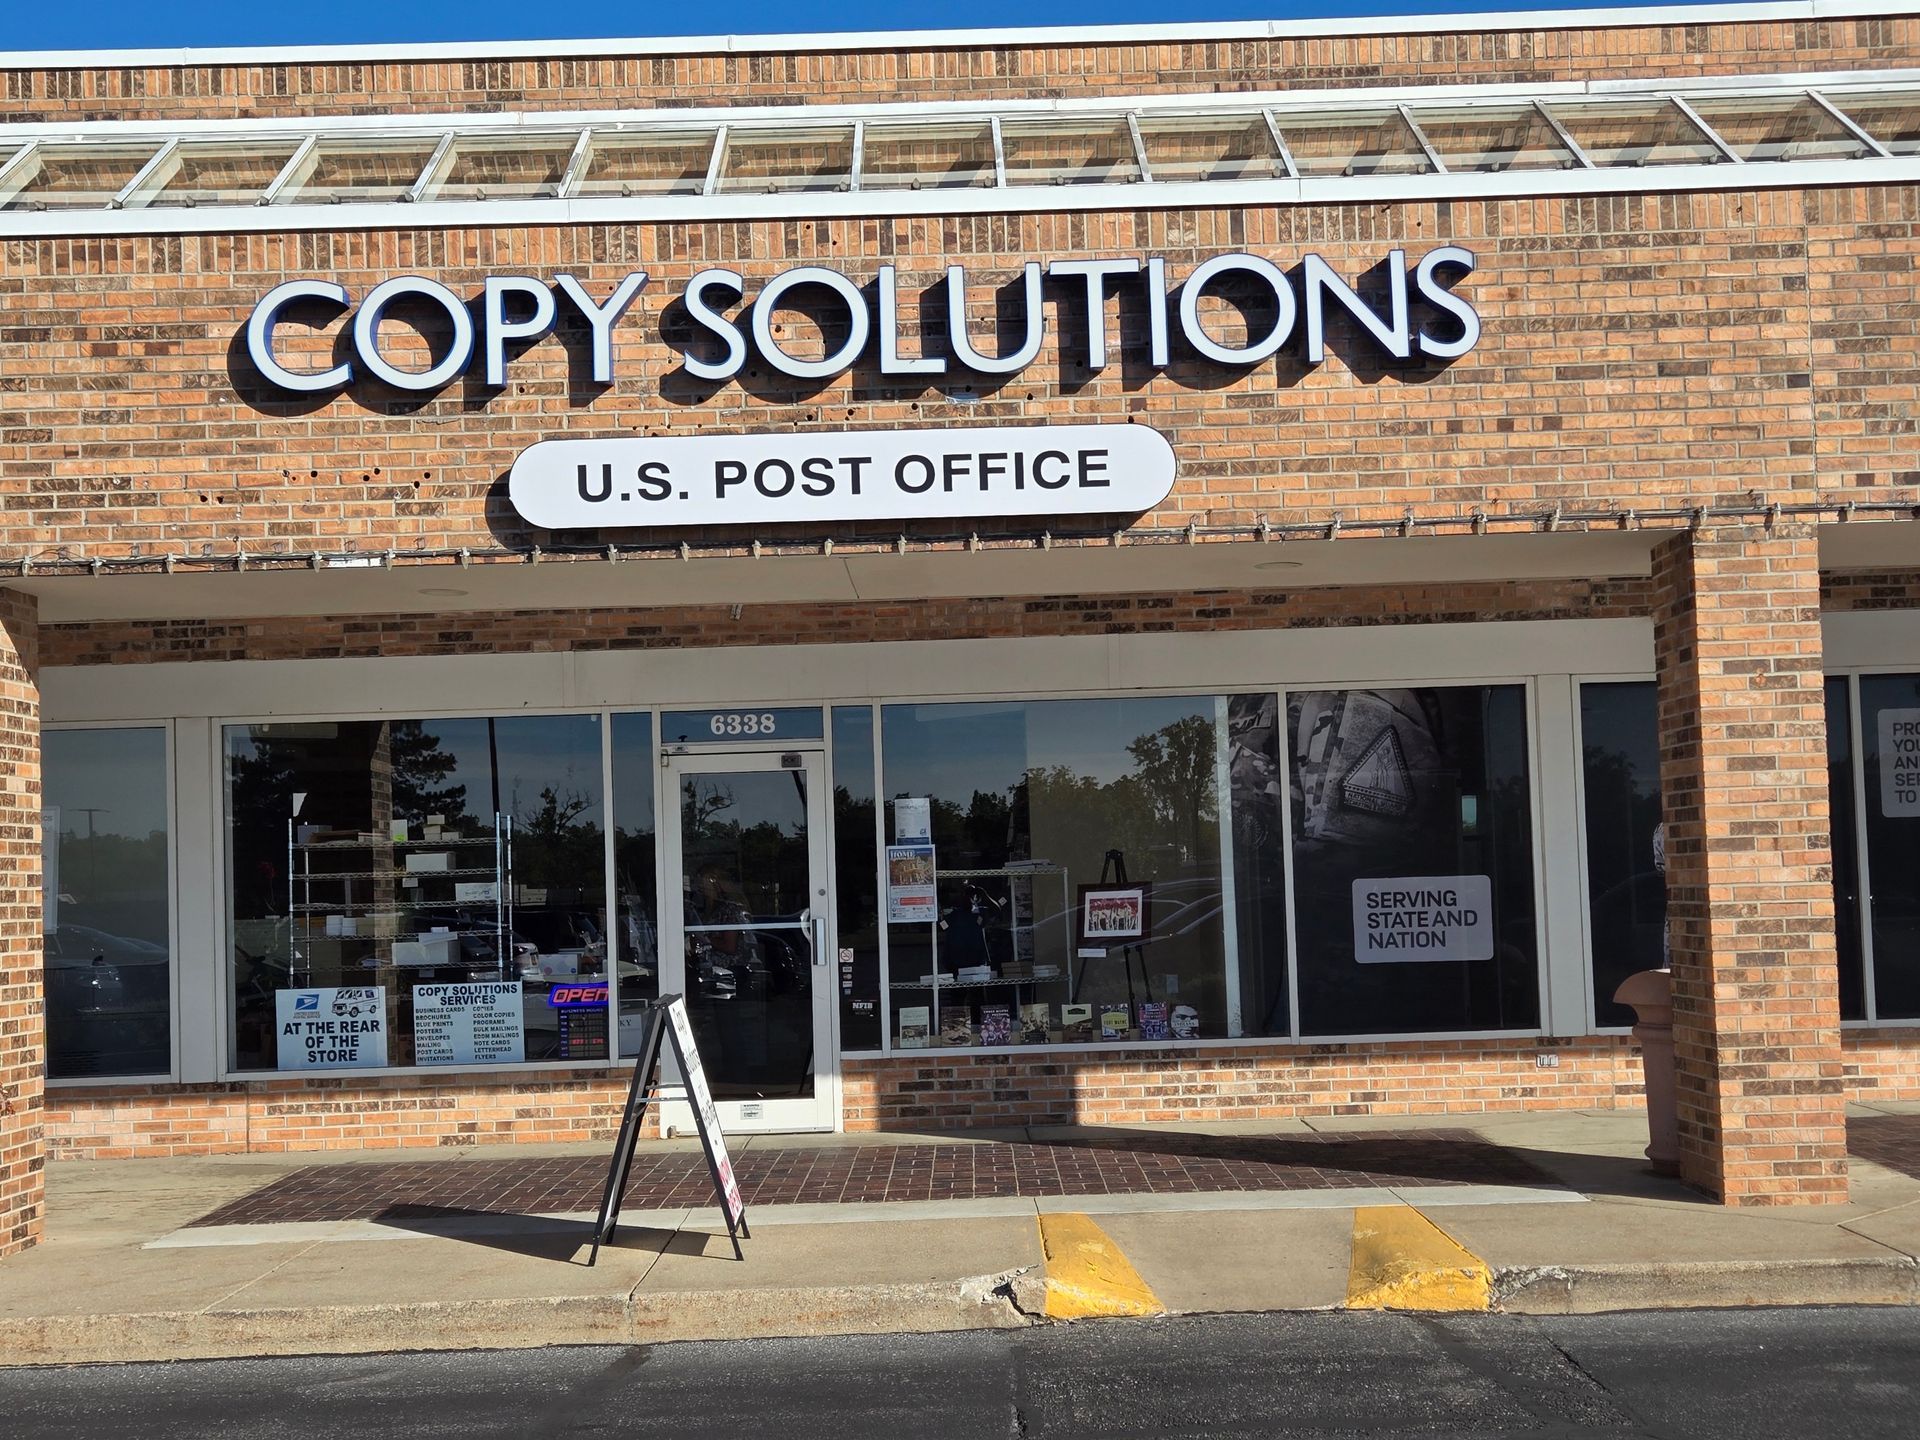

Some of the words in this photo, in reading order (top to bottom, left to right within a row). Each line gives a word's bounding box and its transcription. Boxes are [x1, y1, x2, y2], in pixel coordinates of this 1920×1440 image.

[247, 271, 650, 391] COPY
[683, 245, 1482, 380] SOLUTIONS
[577, 461, 688, 502] U.S.
[715, 455, 872, 499] POST
[894, 449, 1111, 494] OFFICE
[710, 714, 775, 735] 6338
[1894, 756, 1920, 770] AN
[1894, 790, 1917, 803] TO
[1366, 890, 1457, 909] SERVING
[1367, 911, 1428, 929] STATE
[1432, 909, 1478, 927] AND
[1368, 930, 1446, 949] NATION
[418, 986, 449, 997] COPY
[452, 984, 517, 995] SOLUTIONS
[553, 988, 609, 1003] OPEN
[440, 995, 496, 1006] SERVICES
[283, 1023, 301, 1035] AT
[306, 1022, 335, 1034] THE
[340, 1020, 380, 1033] REAR
[305, 1036, 324, 1048] OF
[329, 1035, 359, 1048] THE
[308, 1050, 357, 1063] STORE
